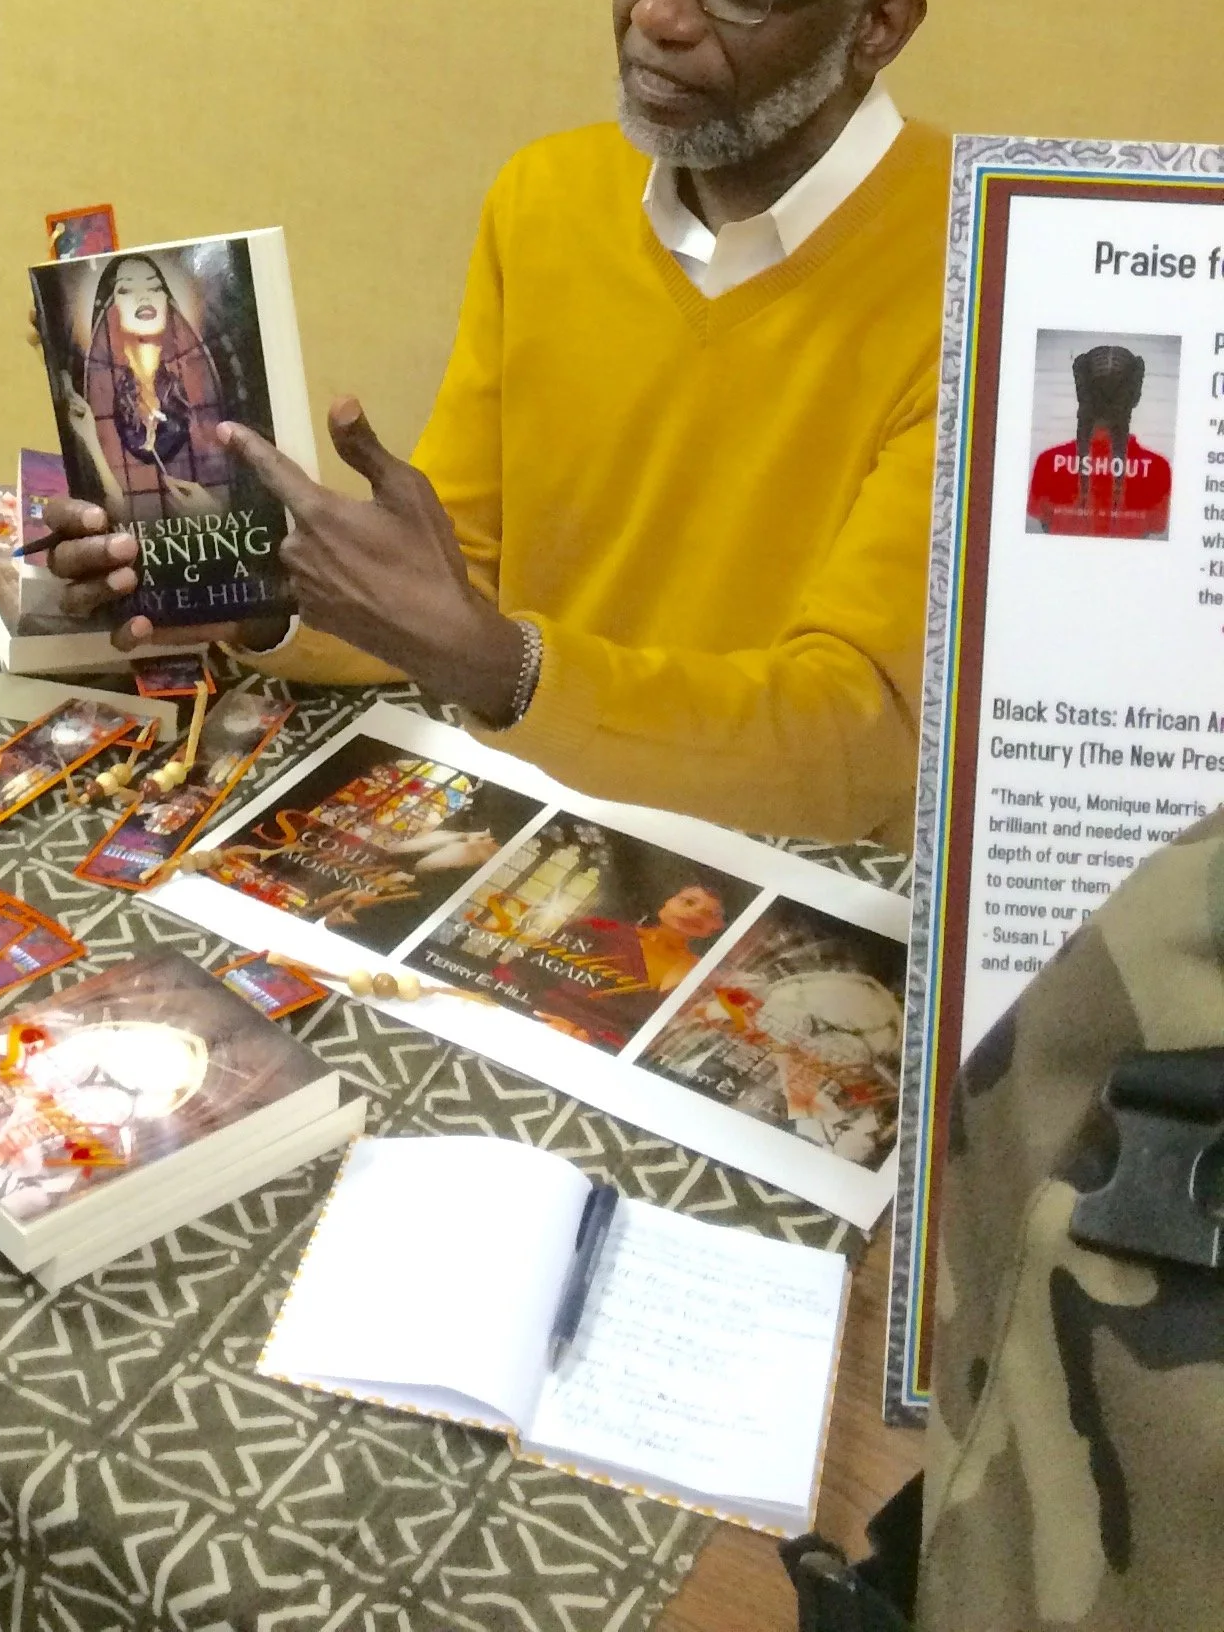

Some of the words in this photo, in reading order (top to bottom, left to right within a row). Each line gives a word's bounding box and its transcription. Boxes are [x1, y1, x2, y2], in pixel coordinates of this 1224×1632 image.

[1094, 241, 1197, 279] Praise
[1053, 453, 1153, 479] PUSHOUT
[155, 509, 254, 538] SUNDAY
[139, 526, 272, 567] RNING
[206, 579, 273, 606] HILL
[1197, 588, 1223, 606] the
[992, 697, 1048, 723] Black
[1055, 701, 1118, 728] Stats:
[1124, 705, 1201, 733] African
[990, 735, 1074, 769] Century
[1079, 741, 1124, 768] (The
[1129, 744, 1176, 769] New
[1049, 795, 1082, 813] you,
[1086, 793, 1151, 817] Monique
[1155, 797, 1207, 817] Morris
[989, 815, 1048, 836] brilliant
[1052, 821, 1082, 838] and
[1085, 825, 1142, 842] needed
[1146, 827, 1182, 844] wor
[987, 844, 1032, 865] depth
[1036, 846, 1053, 864] of
[1056, 851, 1083, 865] our
[1086, 850, 1135, 869] crises
[986, 872, 1002, 888] to
[1006, 875, 1067, 892] counter
[984, 901, 1000, 917] to
[1004, 904, 1047, 919] move
[1051, 905, 1078, 920] our
[992, 926, 1039, 945] Susan
[530, 953, 602, 988] AGAIN
[981, 954, 1010, 971] and
[425, 950, 477, 980] TERRY
[493, 980, 532, 1005] HILL
